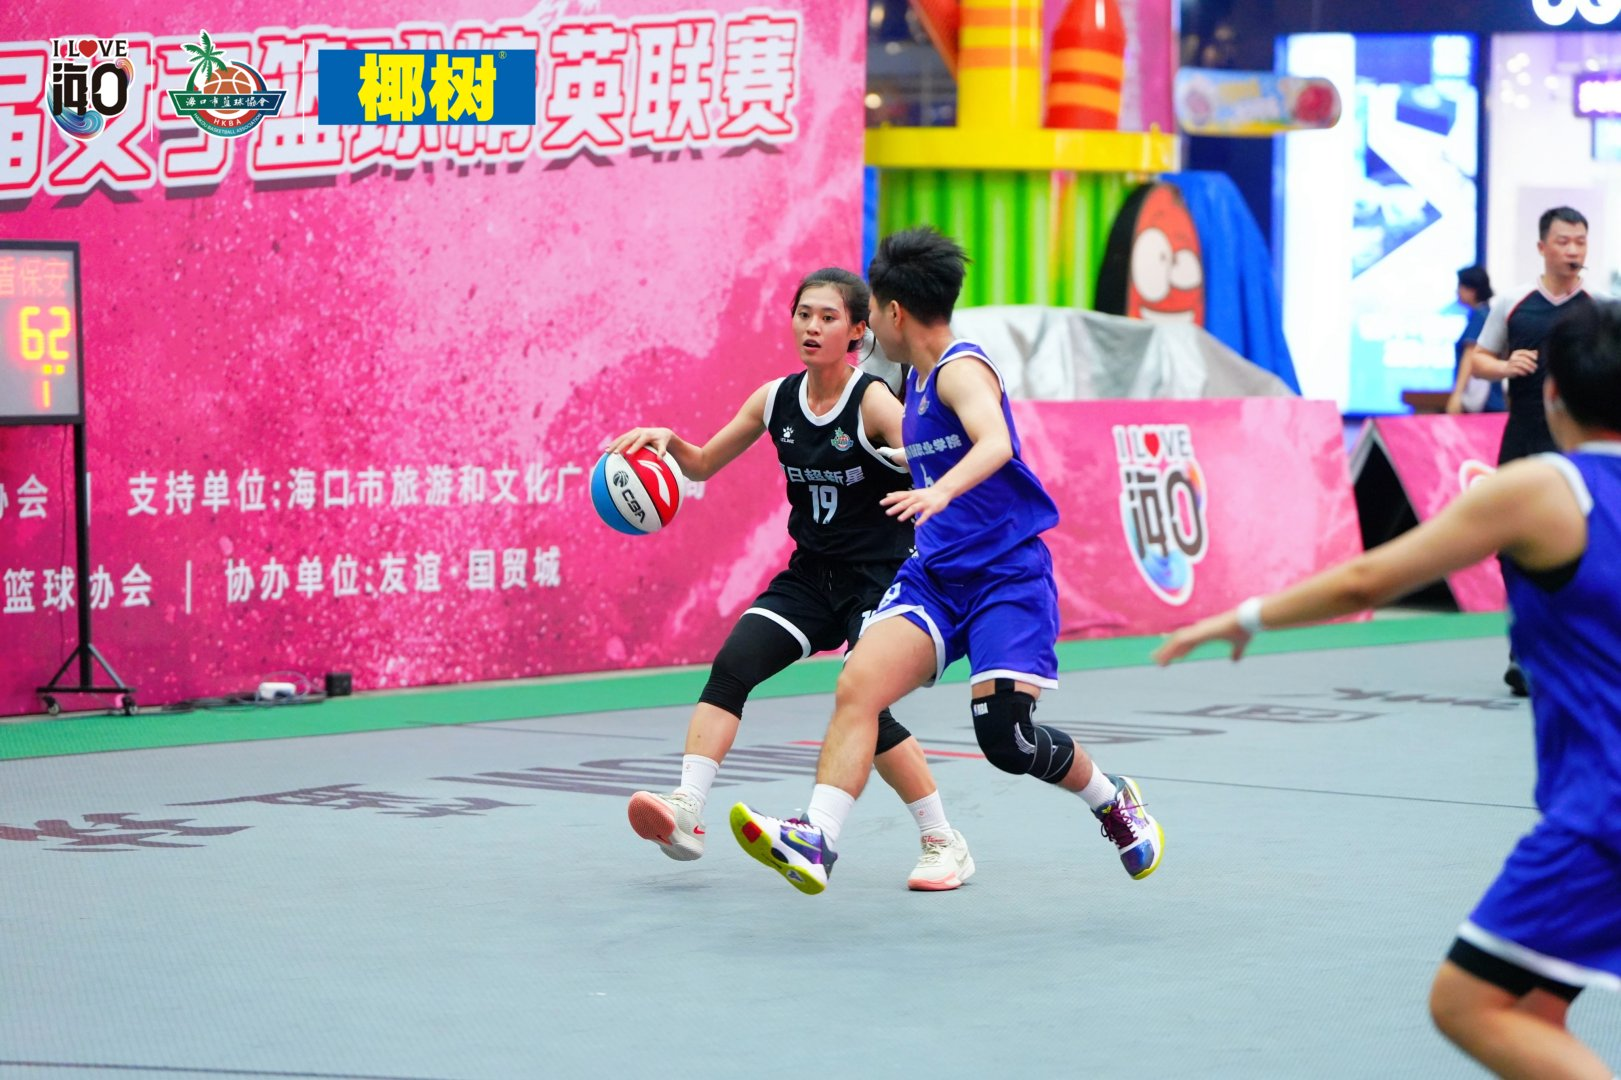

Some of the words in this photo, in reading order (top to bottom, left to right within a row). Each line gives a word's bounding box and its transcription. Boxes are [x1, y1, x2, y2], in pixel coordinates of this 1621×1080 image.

[20, 306, 71, 360] 62
[780, 461, 865, 487] 日超新星
[621, 489, 646, 524] CBA
[808, 484, 838, 525] 19
